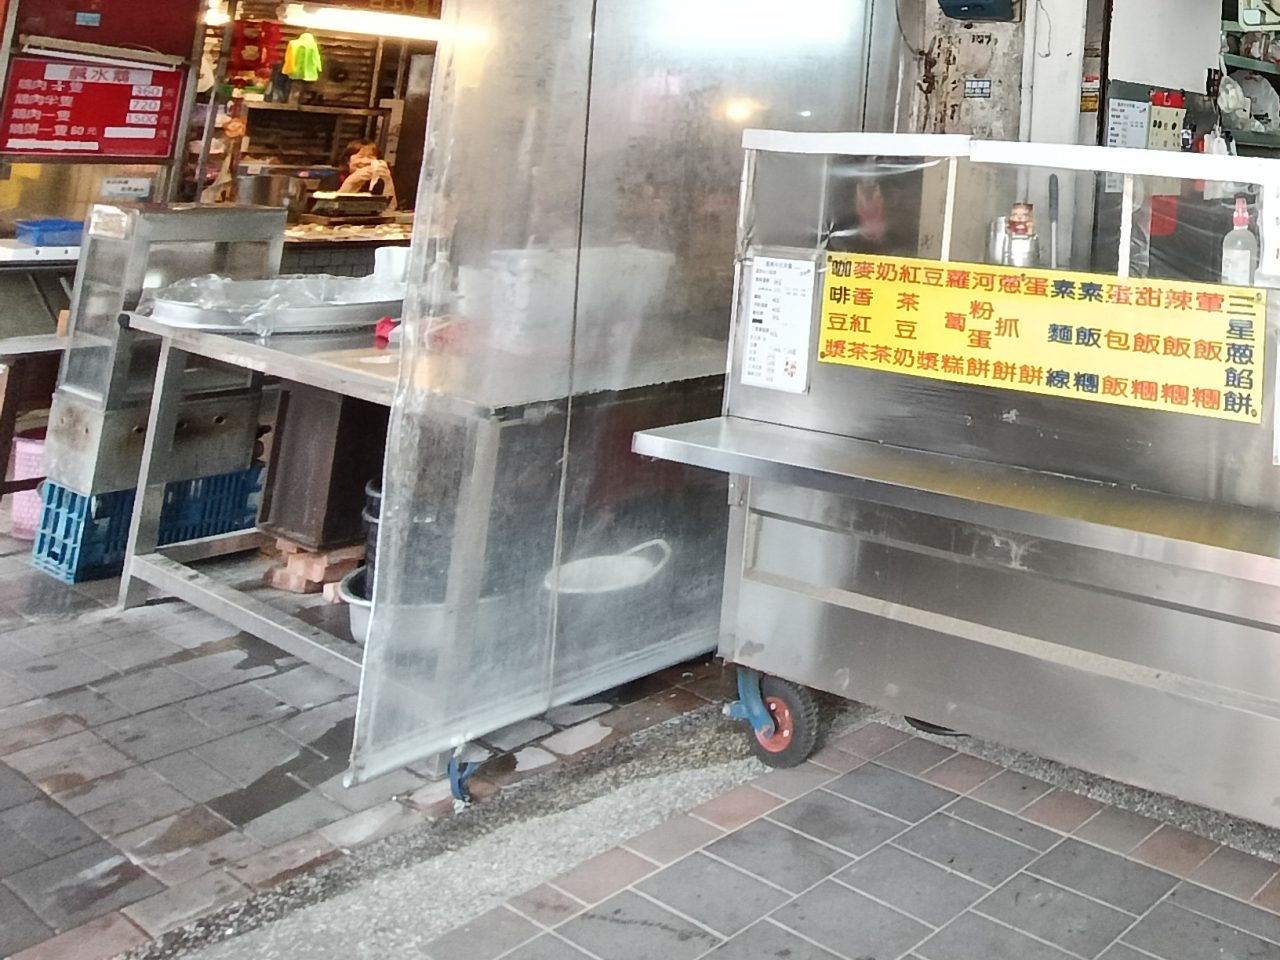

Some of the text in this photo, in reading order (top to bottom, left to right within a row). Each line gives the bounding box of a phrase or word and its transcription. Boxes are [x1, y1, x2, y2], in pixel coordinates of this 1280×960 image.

[825, 260, 852, 358] 咖啡豆漿
[847, 261, 875, 360] 麥香紅茶
[870, 262, 898, 364] 奶茶
[893, 264, 921, 368] 紅茶豆奶
[917, 267, 944, 371] 豆漿
[941, 269, 970, 375] 蘿蔔糕
[966, 271, 996, 378] 河粉蛋餅
[1018, 277, 1048, 386] 蛋餅
[1045, 279, 1075, 389] 素麵線
[1073, 282, 1103, 394] 素飯糰
[1101, 284, 1133, 398] 蛋包飯
[1131, 287, 1163, 402] 甜飯糰
[1161, 288, 1193, 407] 辣飯糰
[1192, 291, 1225, 411] 葷飯糰
